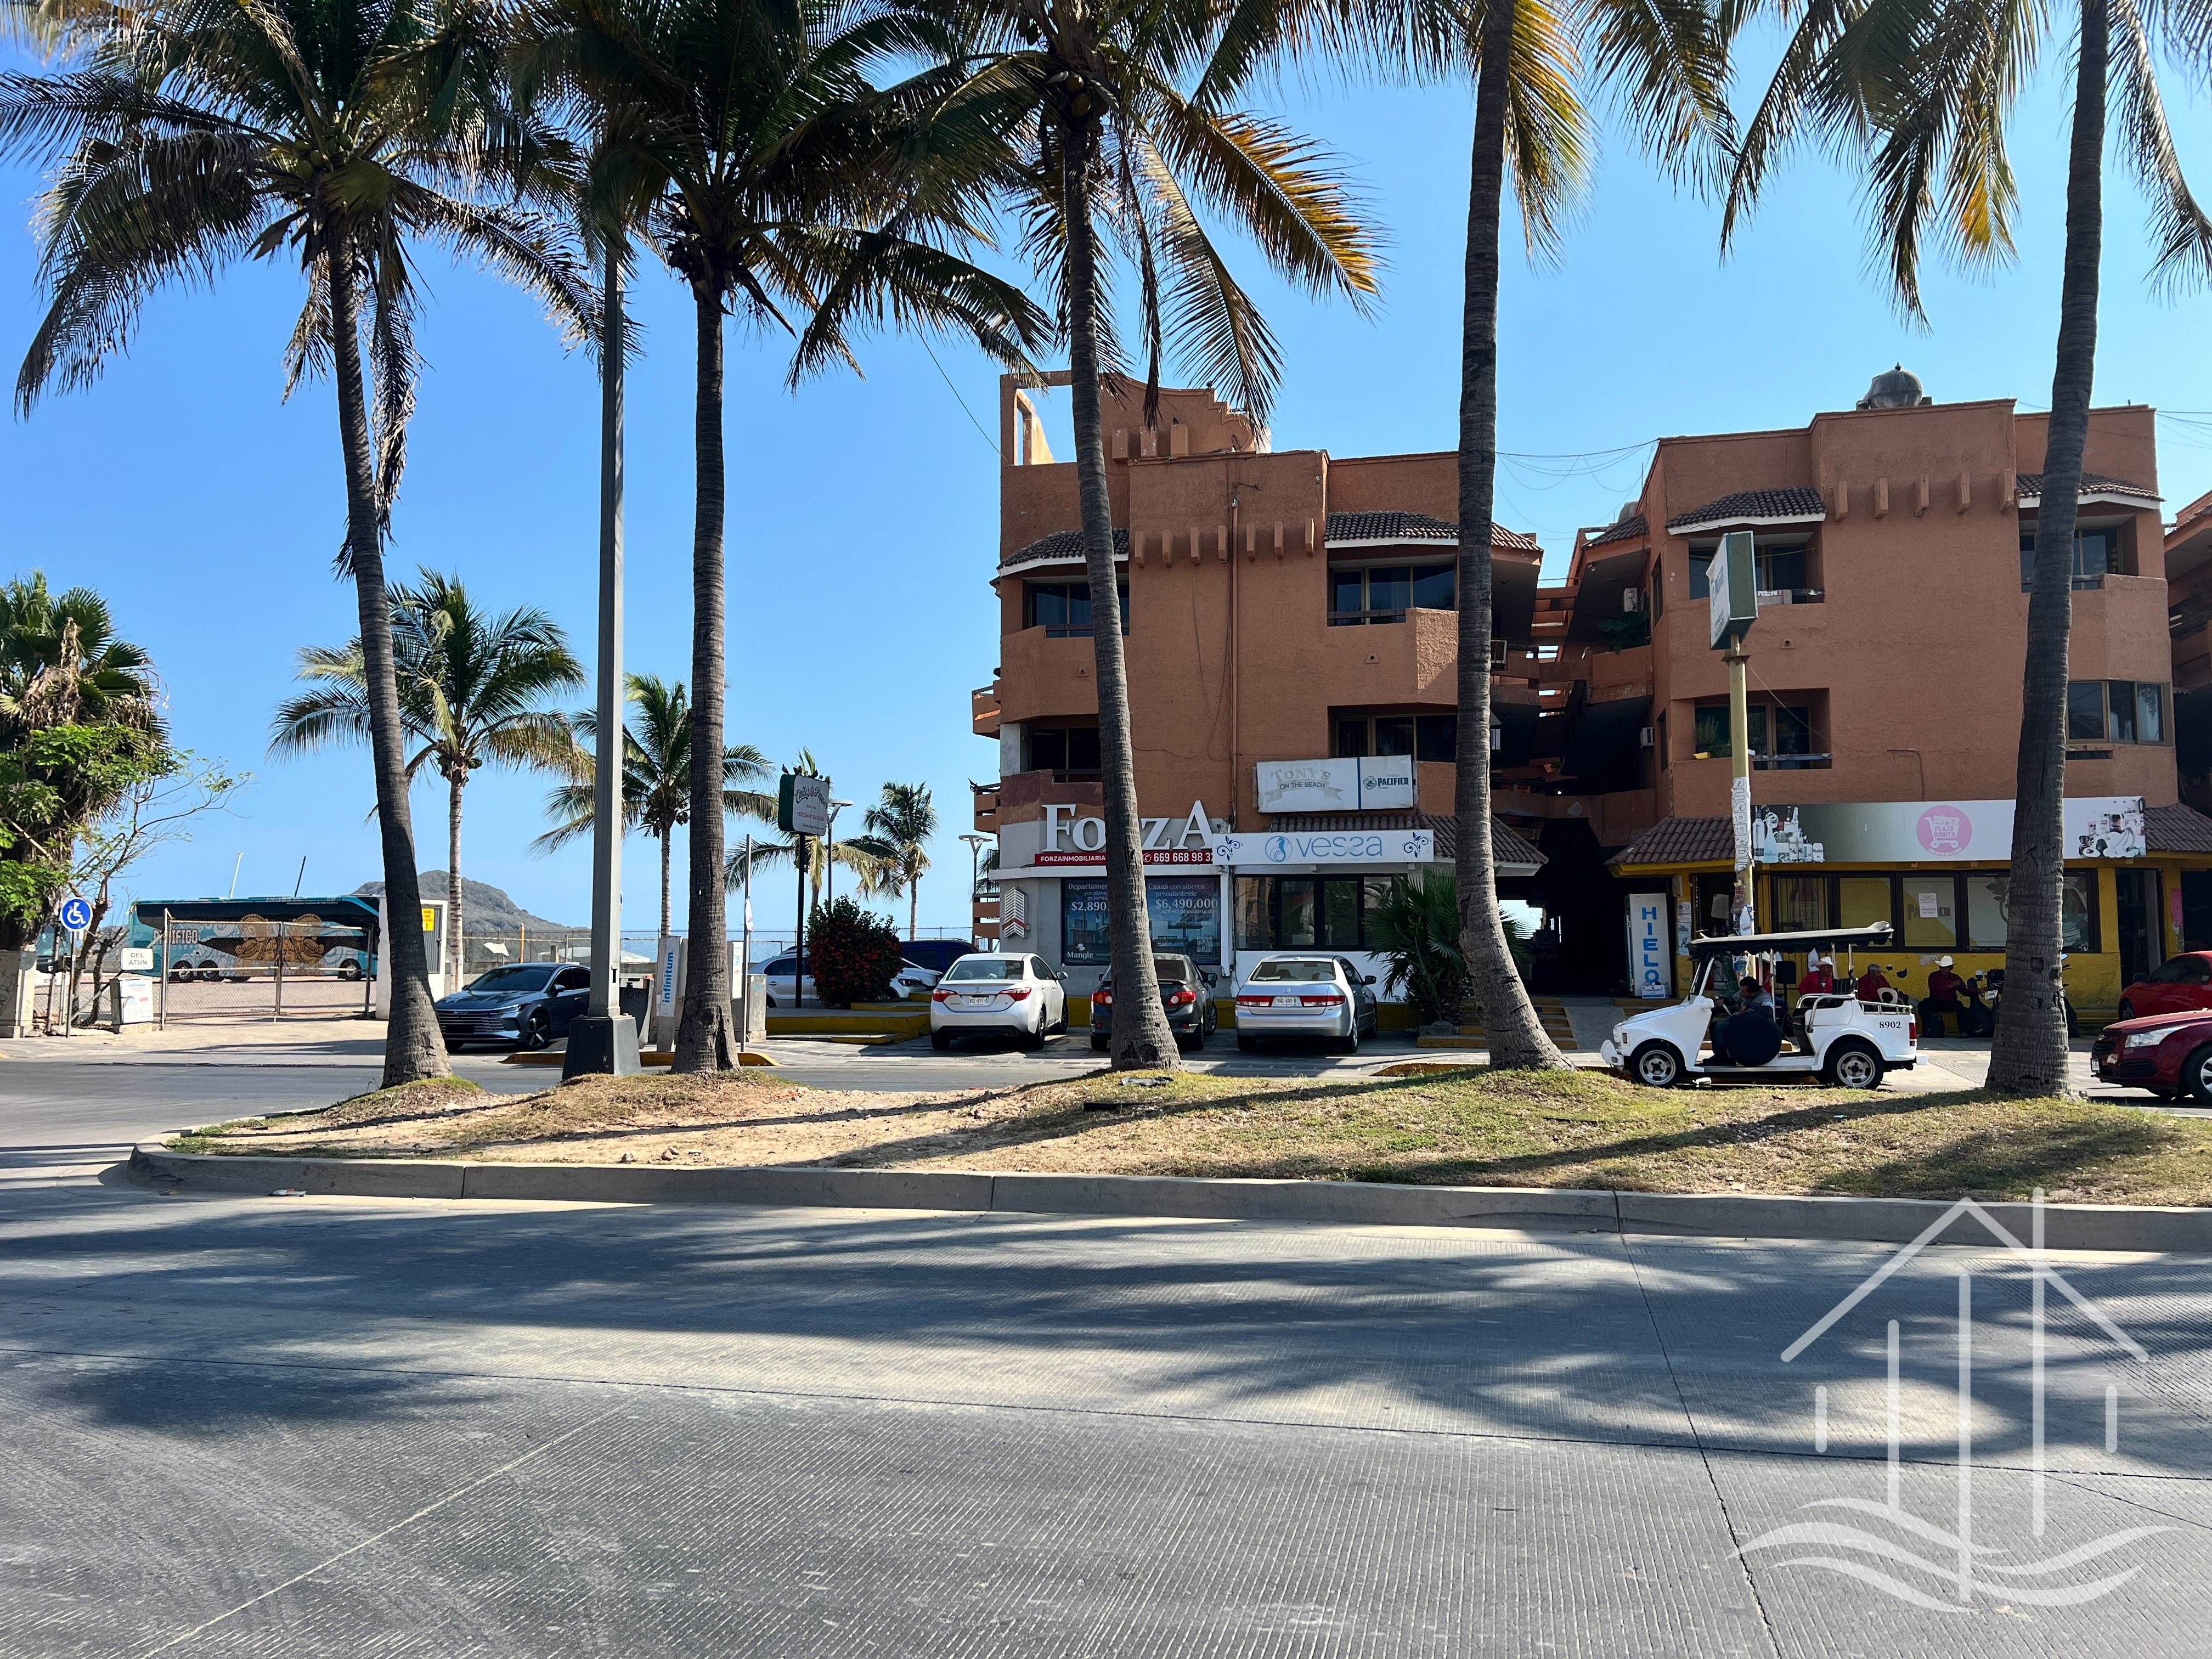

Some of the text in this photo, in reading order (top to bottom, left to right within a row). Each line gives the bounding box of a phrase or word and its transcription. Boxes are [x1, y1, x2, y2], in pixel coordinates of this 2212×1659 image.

[1279, 778, 1325, 790] ON THE BEACH
[1378, 777, 1409, 787] PACIFICO
[1041, 800, 1214, 853] FOZA
[1154, 853, 1170, 862] 669
[1172, 853, 1189, 862] 668
[1192, 853, 1203, 862] 98
[1155, 899, 1218, 909] $6,490,000
[1641, 907, 1659, 984] HIELO
[1067, 951, 1093, 960] Mangle
[662, 952, 674, 1003] infinitum
